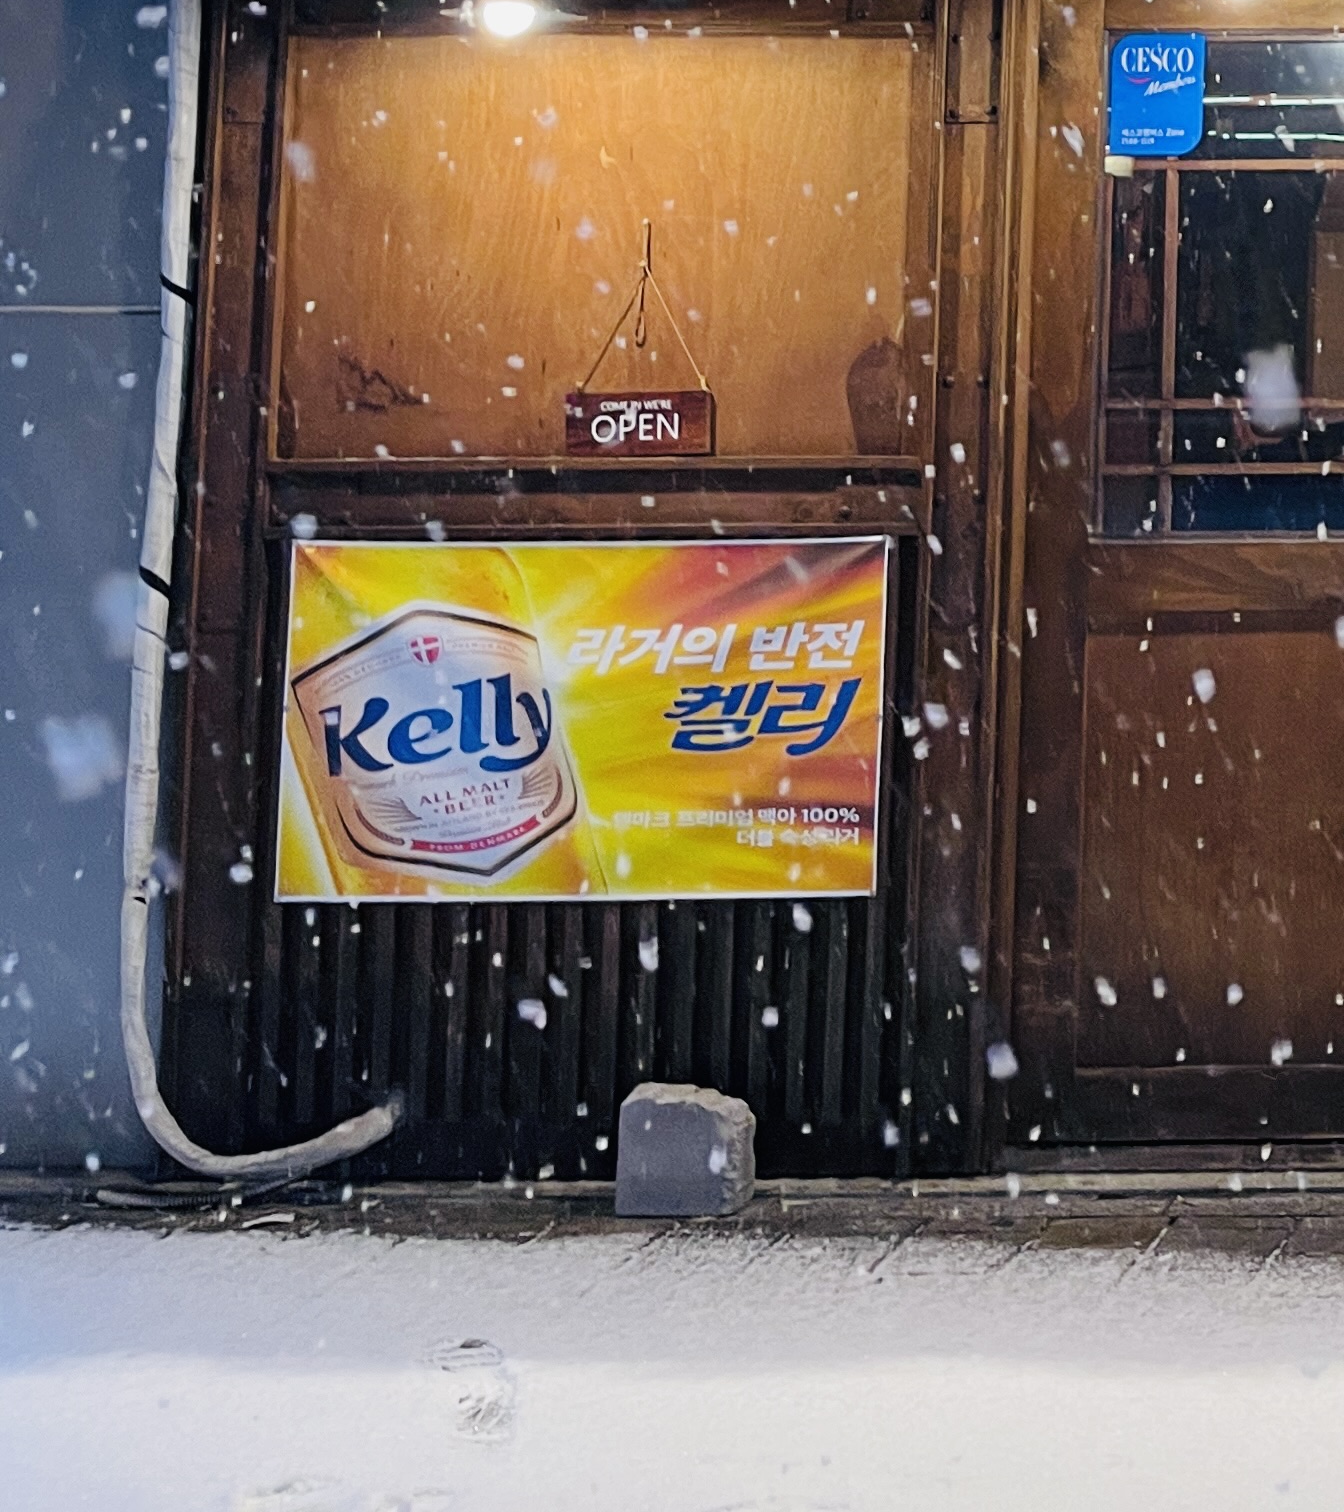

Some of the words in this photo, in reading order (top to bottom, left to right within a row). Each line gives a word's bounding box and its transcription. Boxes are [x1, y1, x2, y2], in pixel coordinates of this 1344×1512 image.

[1121, 46, 1194, 73] CESCO
[591, 412, 680, 443] OPEN
[566, 622, 737, 676] 라거의
[748, 619, 865, 672] 반전
[319, 673, 553, 778] Kelly
[663, 676, 863, 757] 켈리
[462, 778, 511, 798] MALT
[801, 807, 860, 823] 100%
